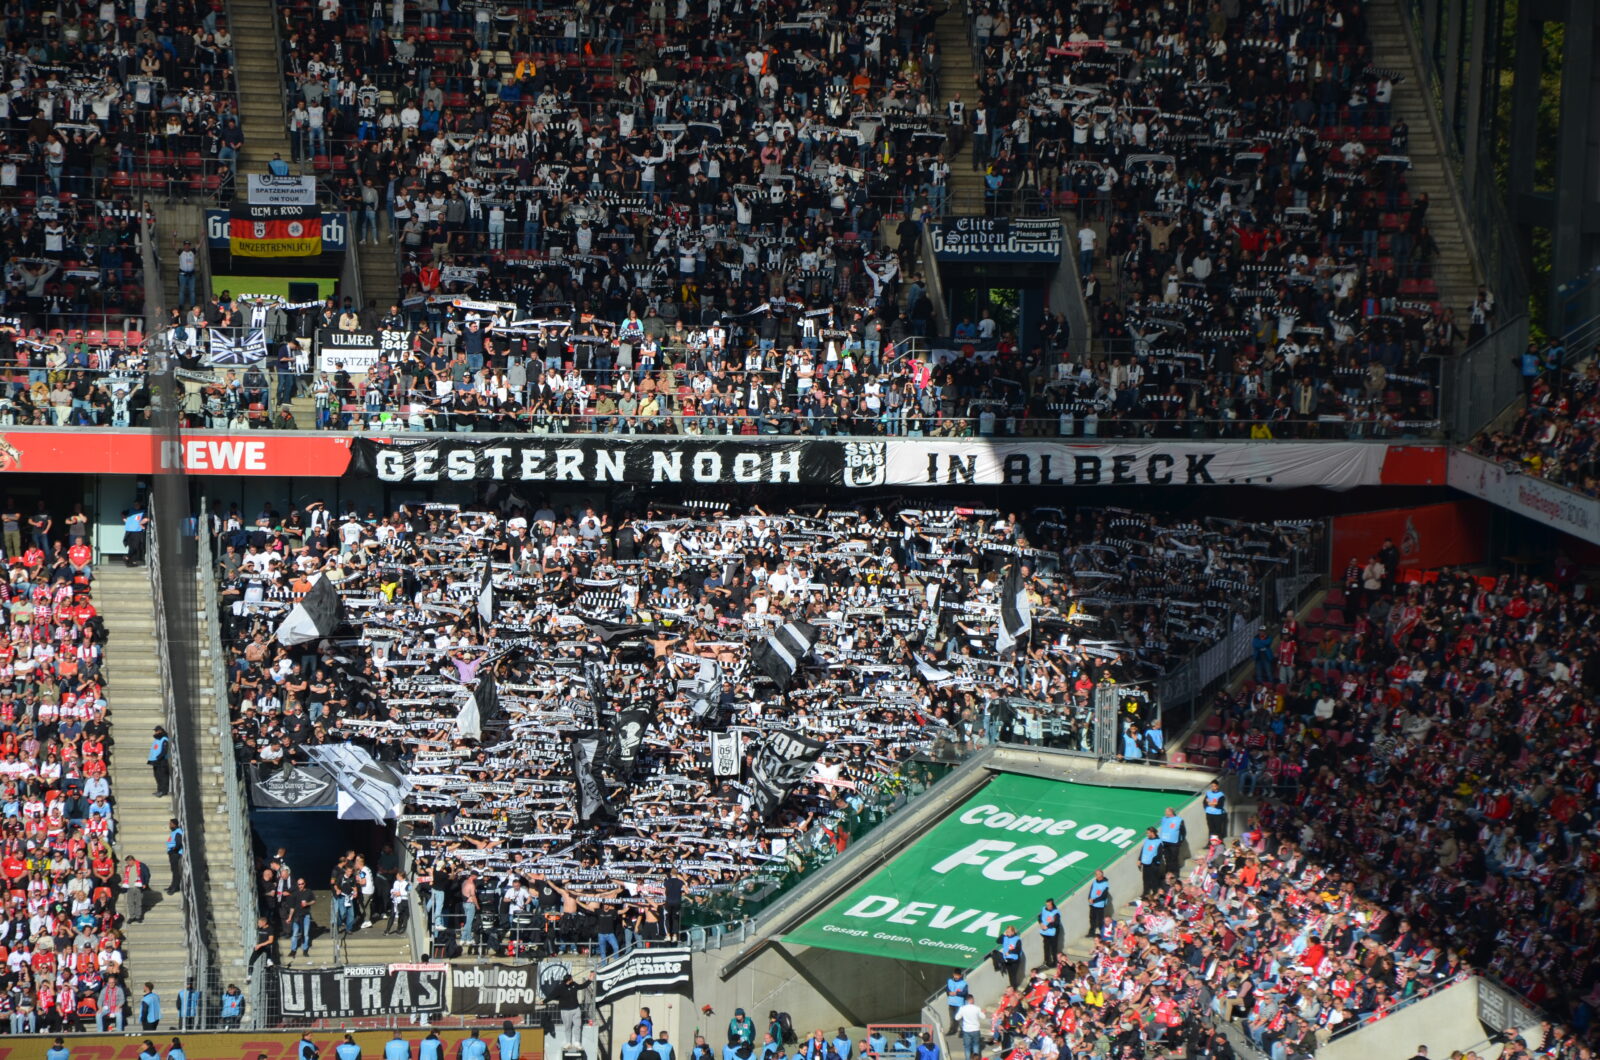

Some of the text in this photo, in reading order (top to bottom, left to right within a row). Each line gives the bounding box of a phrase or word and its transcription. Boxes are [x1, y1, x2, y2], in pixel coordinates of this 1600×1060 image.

[280, 206, 303, 216] RWO
[957, 217, 994, 231] Elite
[946, 230, 1005, 244] Senden
[239, 241, 311, 253] UNZERTRENNLICH
[331, 333, 374, 347] ULMER
[381, 330, 410, 341] SSV
[380, 341, 409, 351] 1846
[161, 440, 267, 470] REWE
[844, 441, 885, 456] SSV
[375, 447, 801, 483] GESTERN NOCH
[844, 455, 885, 468] 1846
[926, 452, 978, 485] IN
[404, 721, 446, 730] ULMER
[959, 804, 1137, 849] Come on,
[931, 838, 1089, 886] FC!
[593, 882, 620, 890] SOCIETY
[842, 894, 1023, 938] DEVK
[344, 967, 386, 977] PRODIGYS
[453, 966, 528, 988] nebulosa
[281, 970, 440, 1012] ULTRAS
[477, 985, 535, 1014] impero
[363, 1006, 417, 1016] SOCIETY
